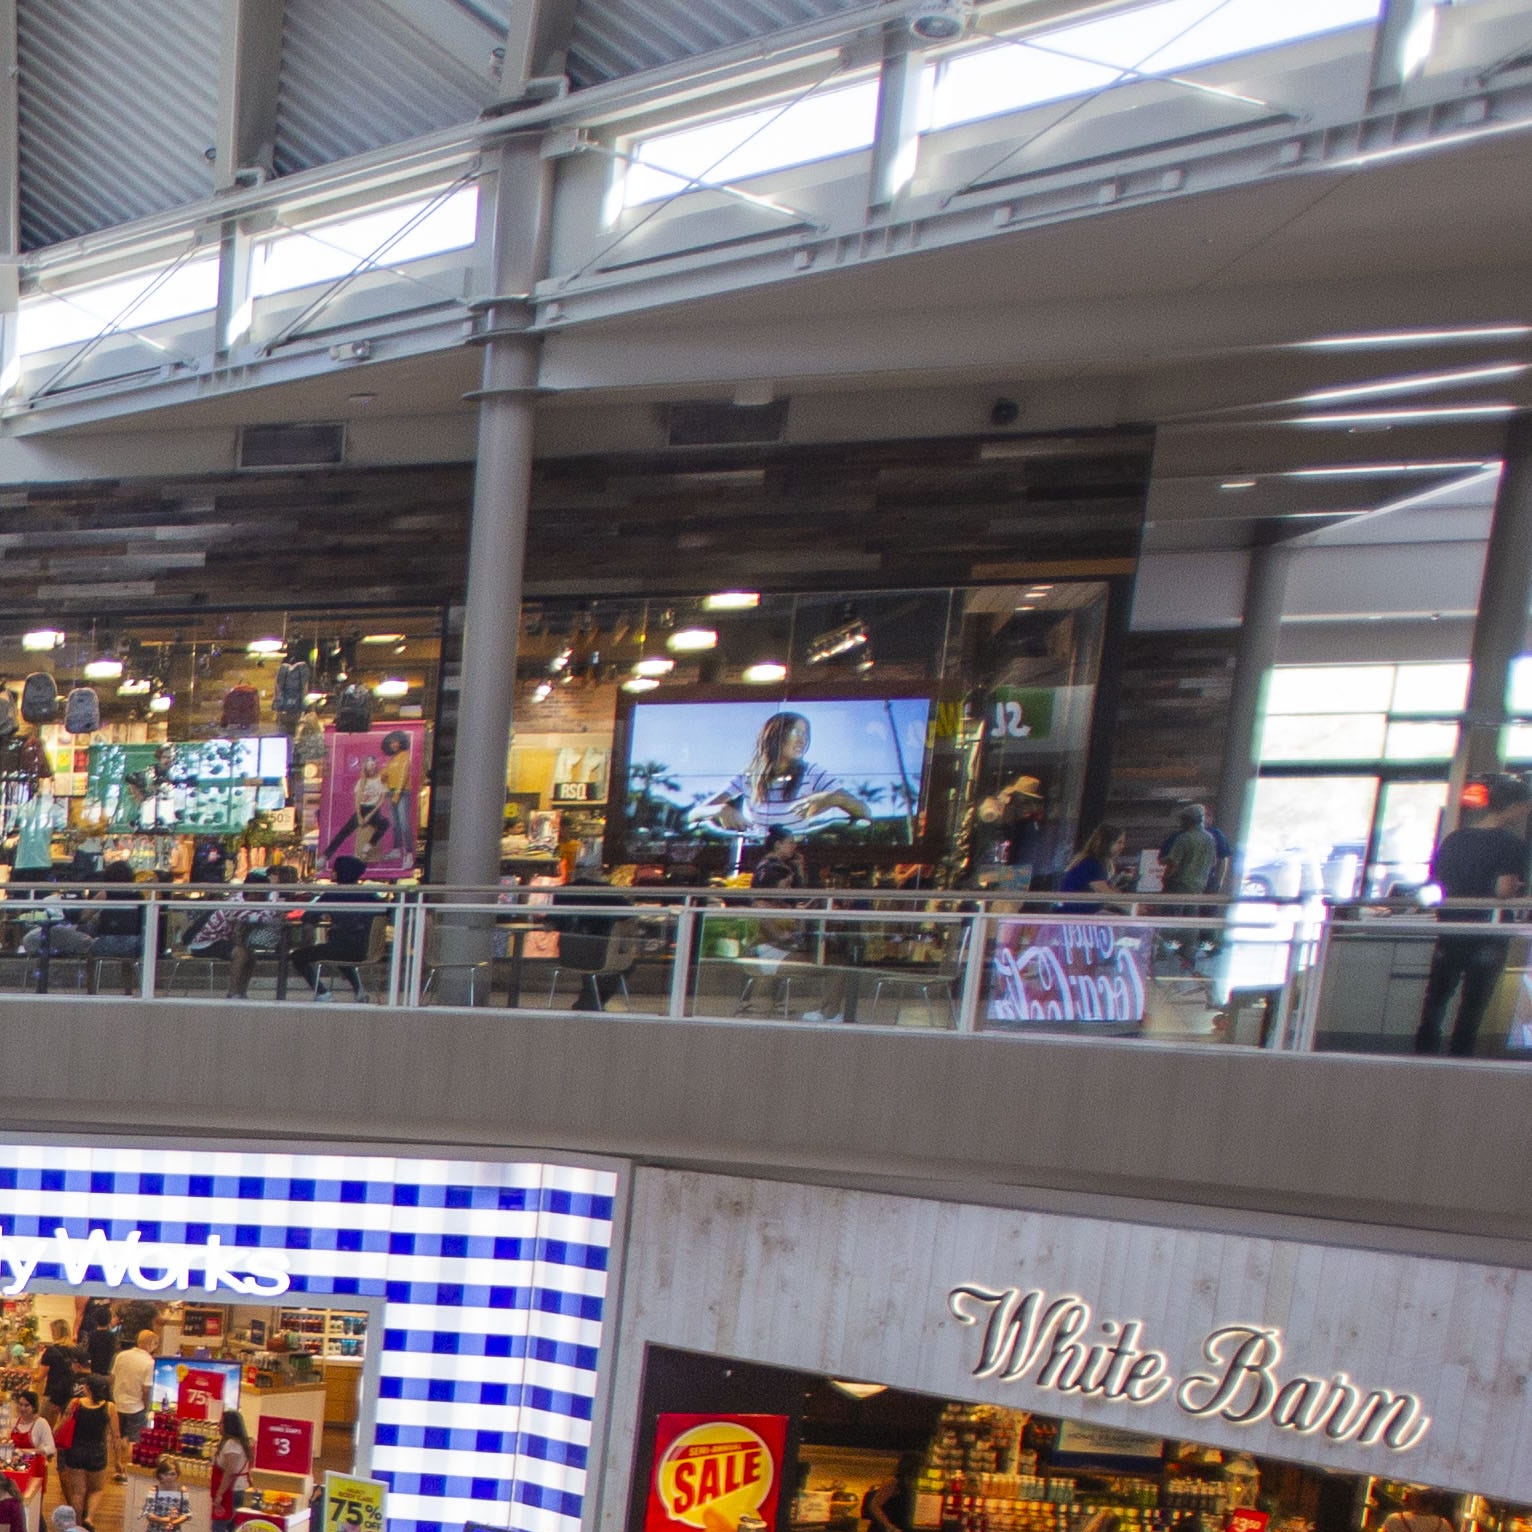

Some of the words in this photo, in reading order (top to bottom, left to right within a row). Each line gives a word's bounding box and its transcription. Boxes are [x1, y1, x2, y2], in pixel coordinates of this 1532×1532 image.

[560, 783, 587, 800] RSQ
[54, 1226, 291, 1297] Works
[947, 1285, 1172, 1404] White
[1176, 1325, 1431, 1452] Barn
[273, 1437, 291, 1455] $3
[673, 1452, 761, 1514] SALE
[364, 1521, 383, 1530] OFF
